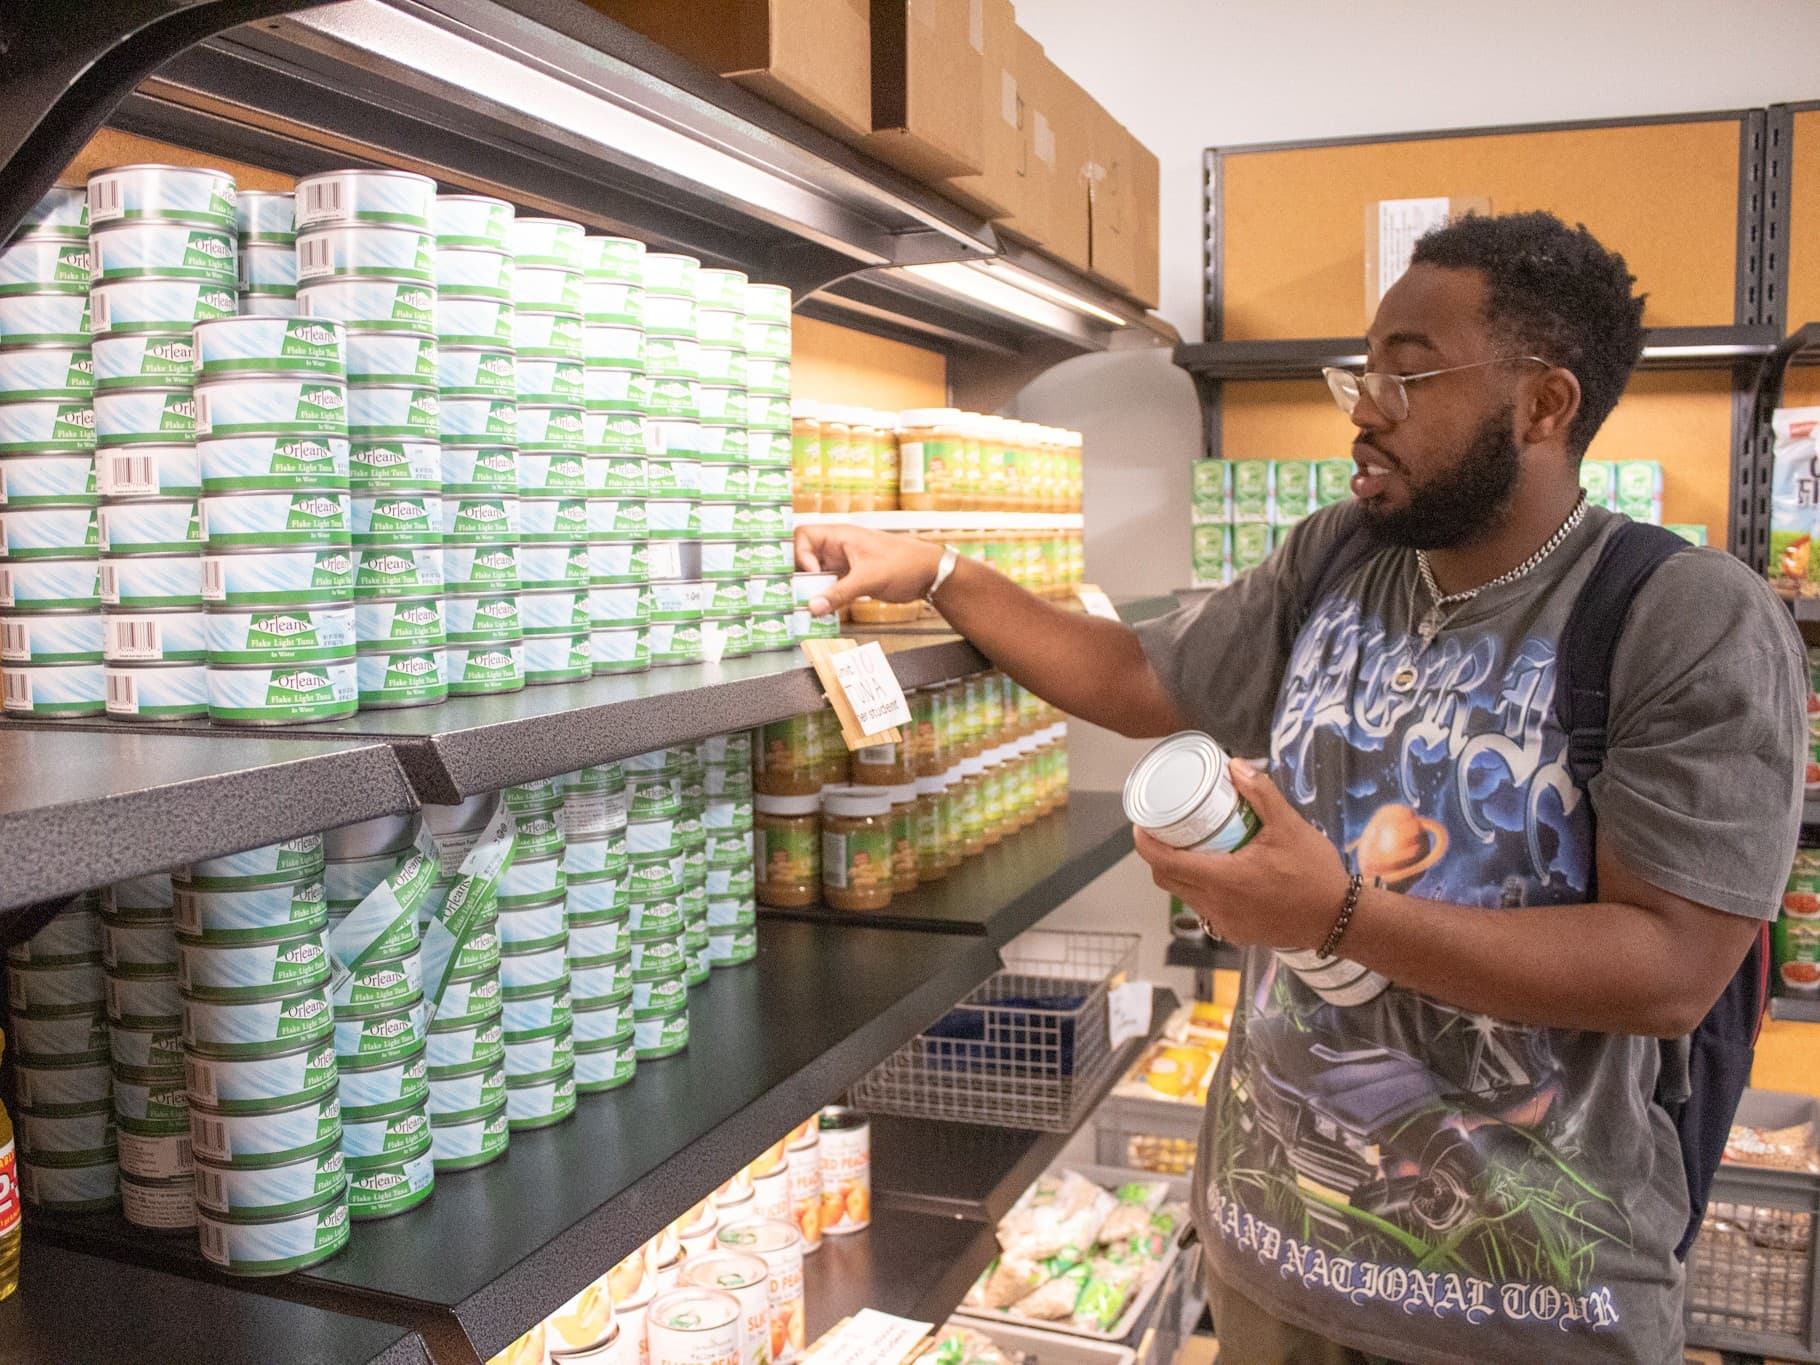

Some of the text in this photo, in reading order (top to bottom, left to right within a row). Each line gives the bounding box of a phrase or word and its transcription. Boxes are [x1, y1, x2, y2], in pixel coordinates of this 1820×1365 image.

[295, 324, 334, 343] Orleans
[287, 346, 306, 354] Flake
[283, 440, 328, 458] Orleans
[356, 448, 402, 464] Orleans
[275, 464, 295, 472] Flake
[298, 464, 317, 473] Light
[371, 469, 389, 478] Light
[299, 496, 338, 514] Orleans
[382, 500, 422, 517] Orleans
[465, 504, 502, 520] Orleans
[292, 520, 311, 528] Flake
[314, 519, 330, 530] Light
[396, 522, 413, 531] Light
[368, 555, 411, 571] Orleans
[382, 576, 400, 585] Light
[402, 607, 435, 622] Orleans
[259, 615, 307, 633] Orleans
[251, 639, 271, 647] Flake
[274, 639, 294, 649] Light
[396, 657, 433, 673] Orleans
[475, 652, 510, 668] Orleans
[279, 671, 326, 689] Orleans
[271, 695, 291, 703] Flake
[294, 694, 314, 704] Light
[868, 700, 899, 719] student
[396, 855, 421, 886] Orleans
[444, 879, 470, 917] Orleans
[285, 945, 321, 963] Orleans
[278, 970, 296, 978] Flake
[299, 964, 313, 975] Light
[362, 971, 402, 987] Orleans
[288, 1001, 324, 1018] Orleans
[282, 1026, 300, 1035] Flake
[370, 1021, 408, 1036] Orleans
[394, 1116, 424, 1133] Orleans
[360, 1174, 402, 1189] Orleans
[1280, 1239, 1495, 1325] NATIONAL
[1501, 1282, 1620, 1332] TOUR
